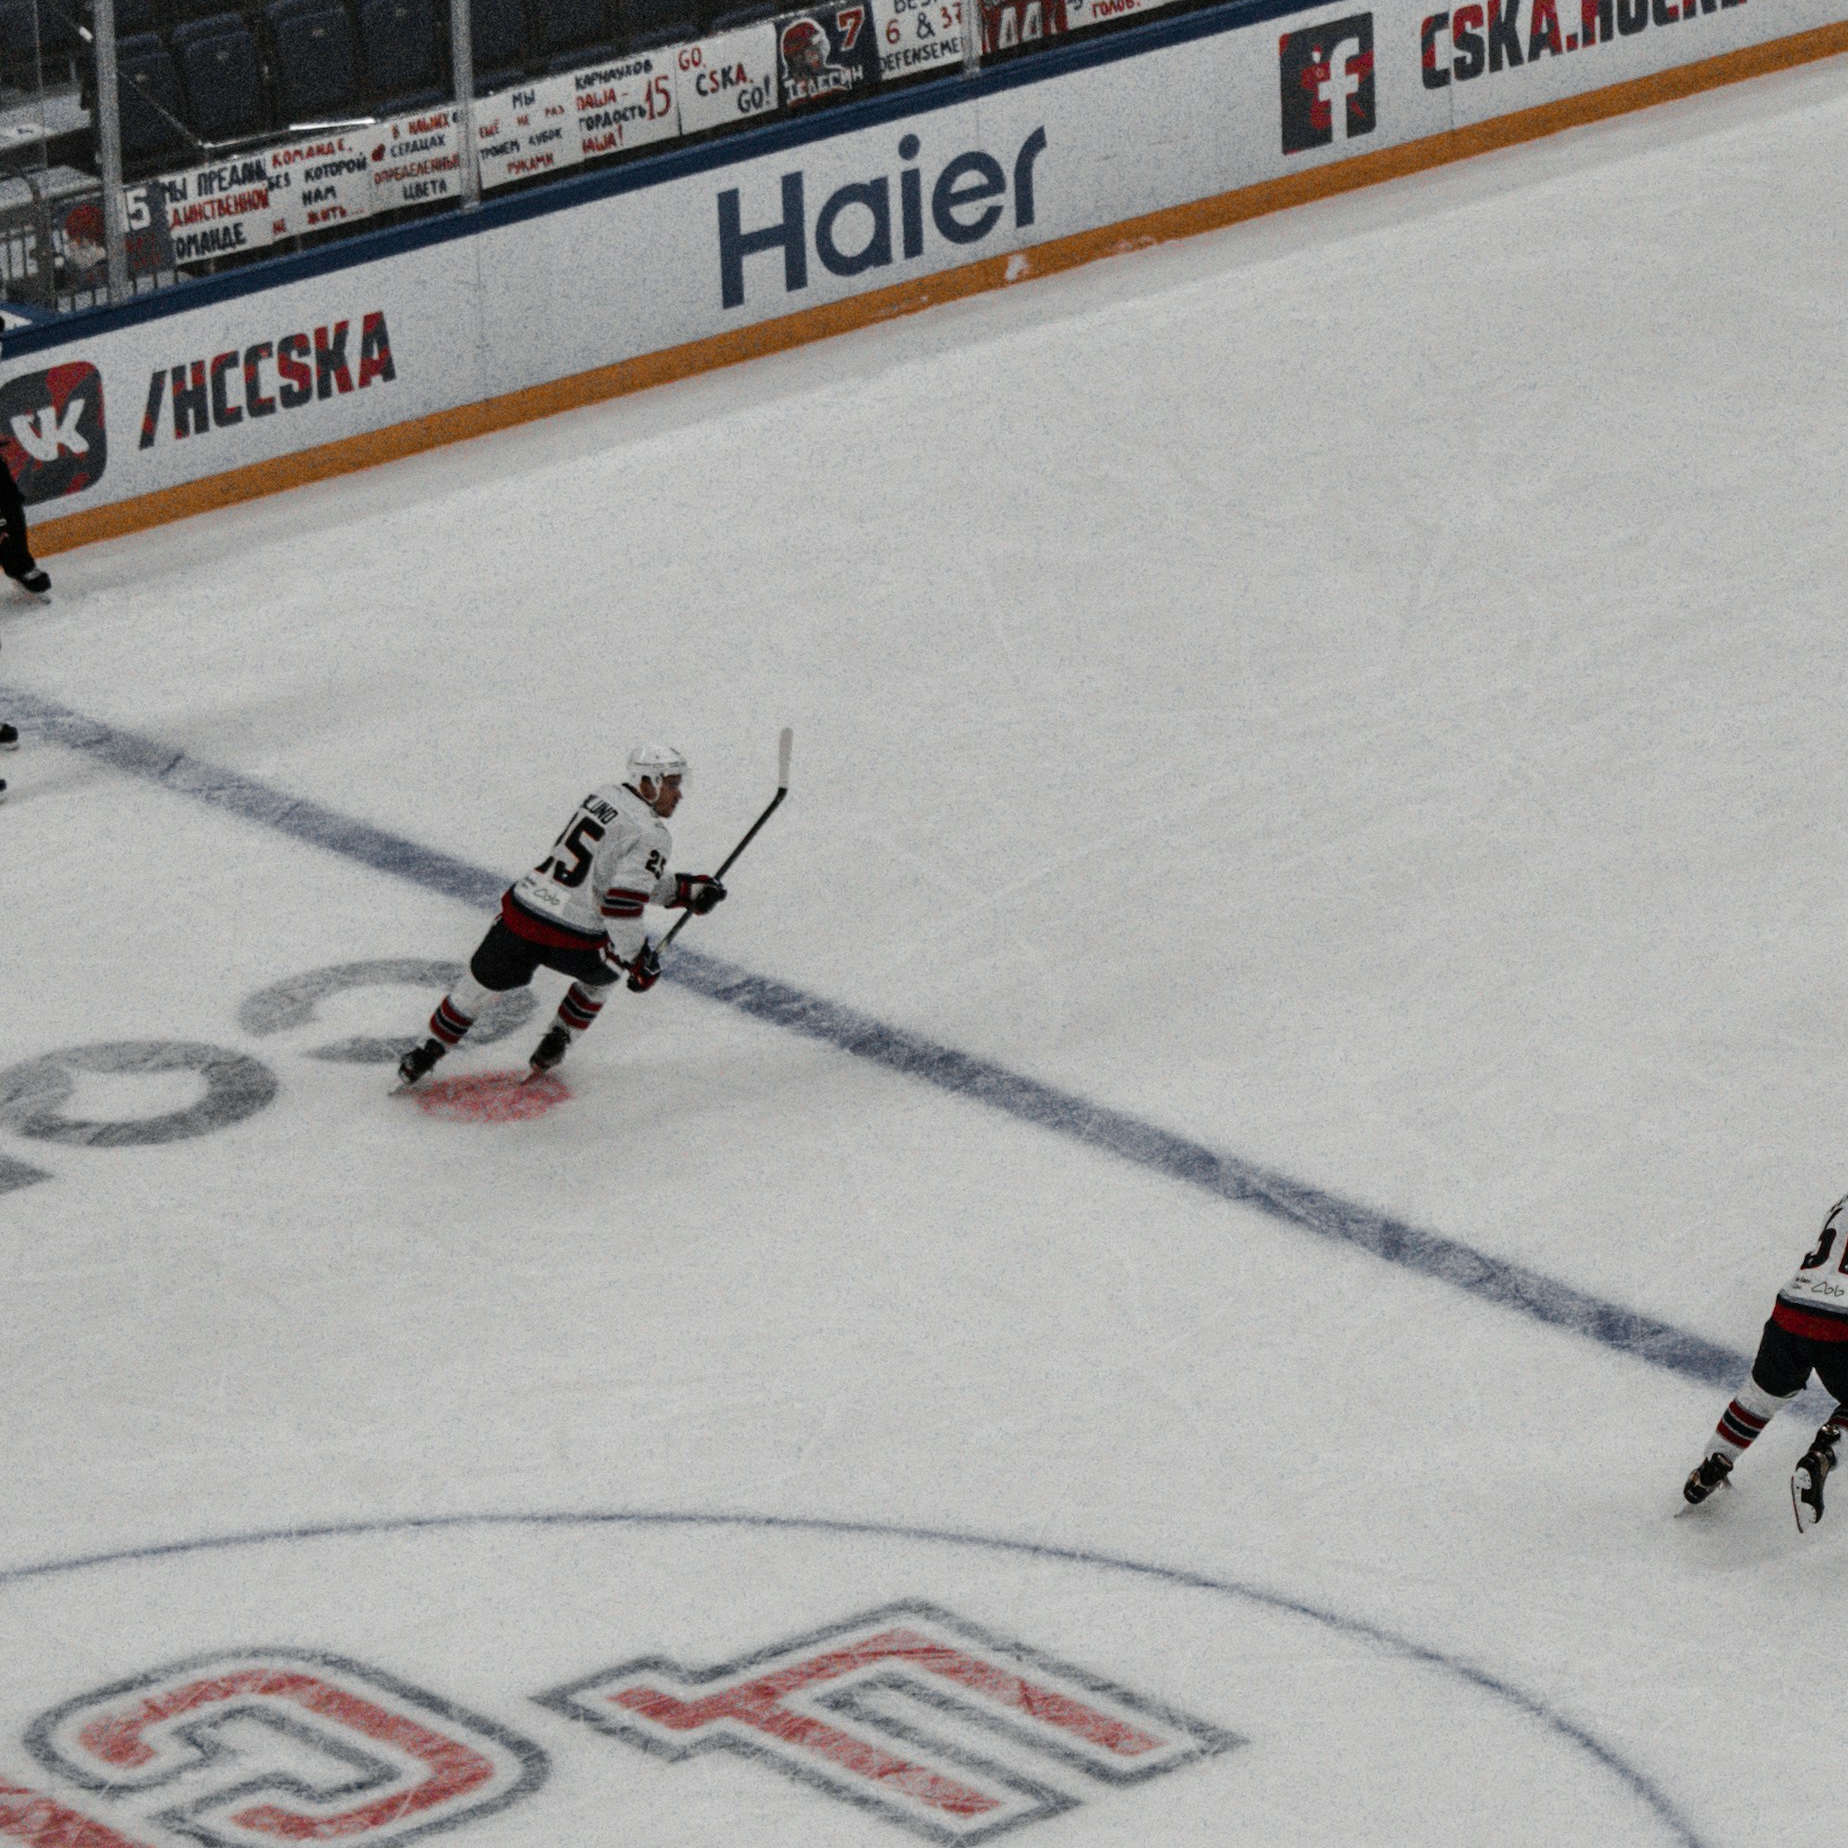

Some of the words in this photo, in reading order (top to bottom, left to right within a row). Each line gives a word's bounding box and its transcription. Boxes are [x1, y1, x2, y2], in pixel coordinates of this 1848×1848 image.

[835, 4, 865, 52] 7
[885, 19, 900, 45] 6
[916, 11, 936, 39] &
[879, 36, 963, 72] DEFENSEME
[512, 89, 536, 110] МЫ
[645, 74, 672, 122] 15
[737, 74, 771, 115] GO!
[578, 104, 648, 134] ГОРДОСТЬ
[304, 155, 368, 184] КОТОРОЙ
[302, 184, 336, 206] НАМ
[402, 178, 448, 203] ЦВЕТА
[716, 124, 1048, 311] Haier
